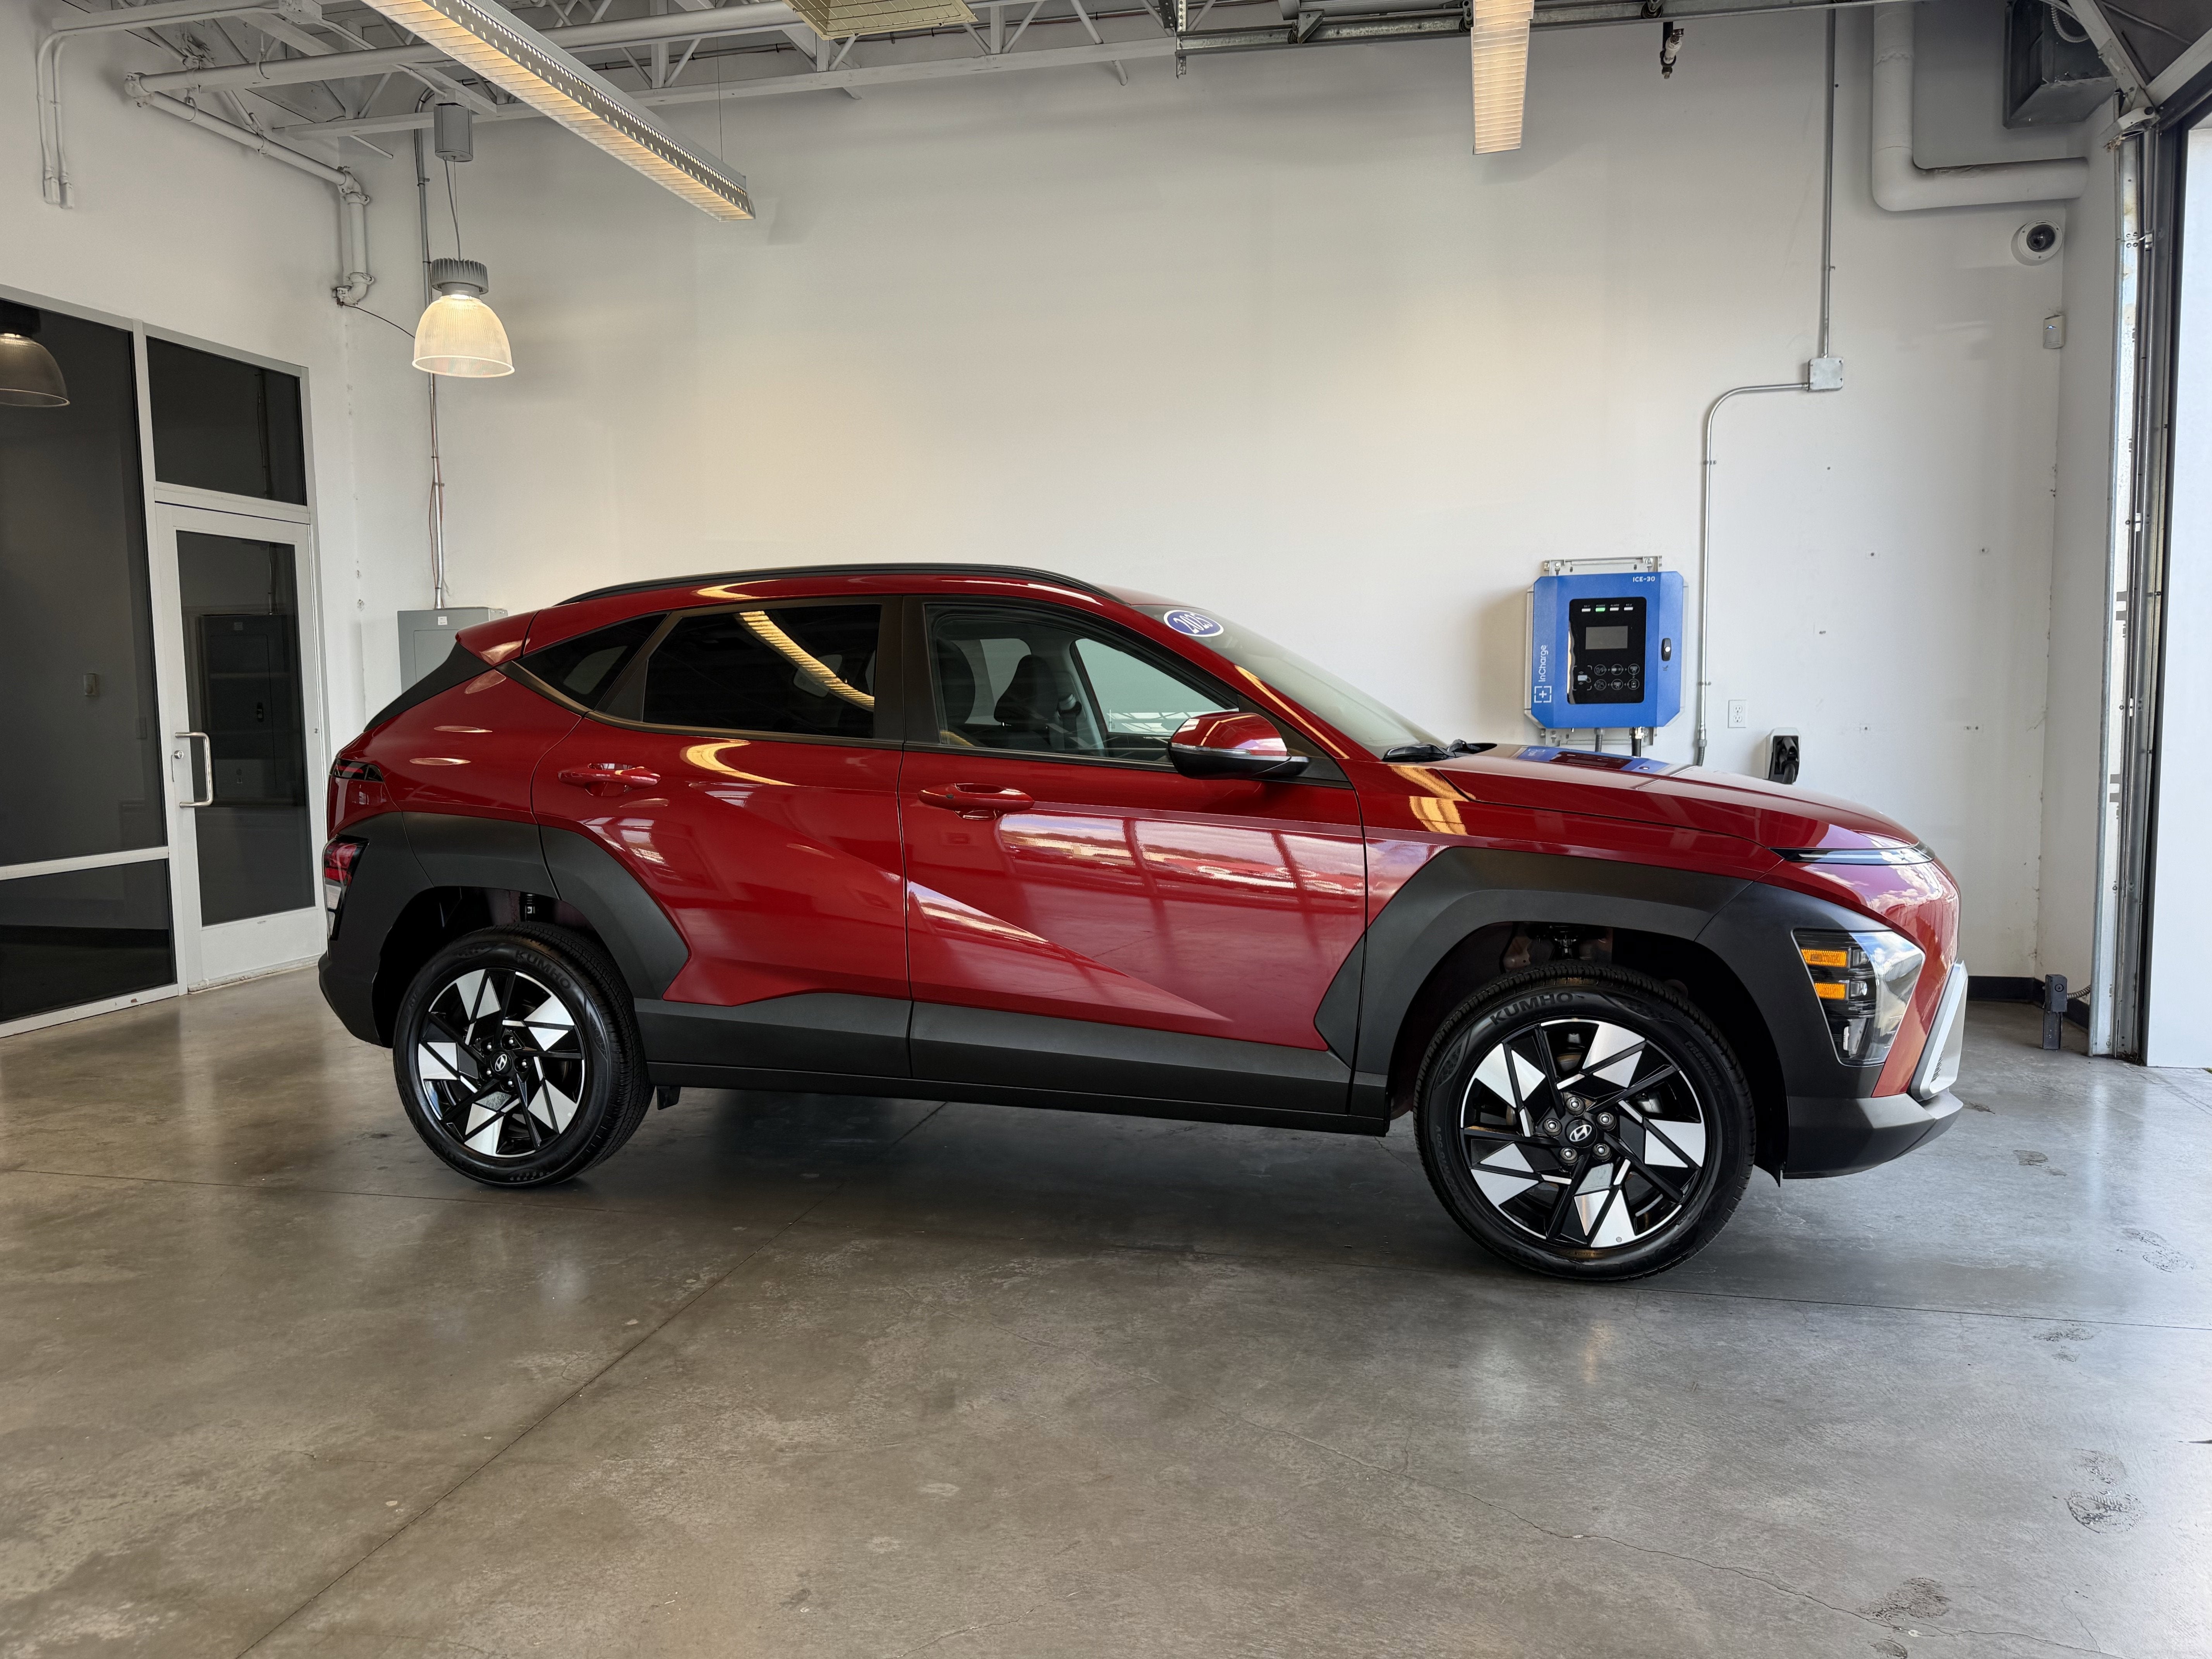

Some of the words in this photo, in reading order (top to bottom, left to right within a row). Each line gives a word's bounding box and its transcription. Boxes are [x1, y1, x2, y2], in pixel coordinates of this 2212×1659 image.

[1173, 613, 1213, 634] 2025
[1539, 645, 1548, 682] InCharge
[515, 950, 571, 989] KUMHO
[1490, 992, 1573, 1025] KUMHO
